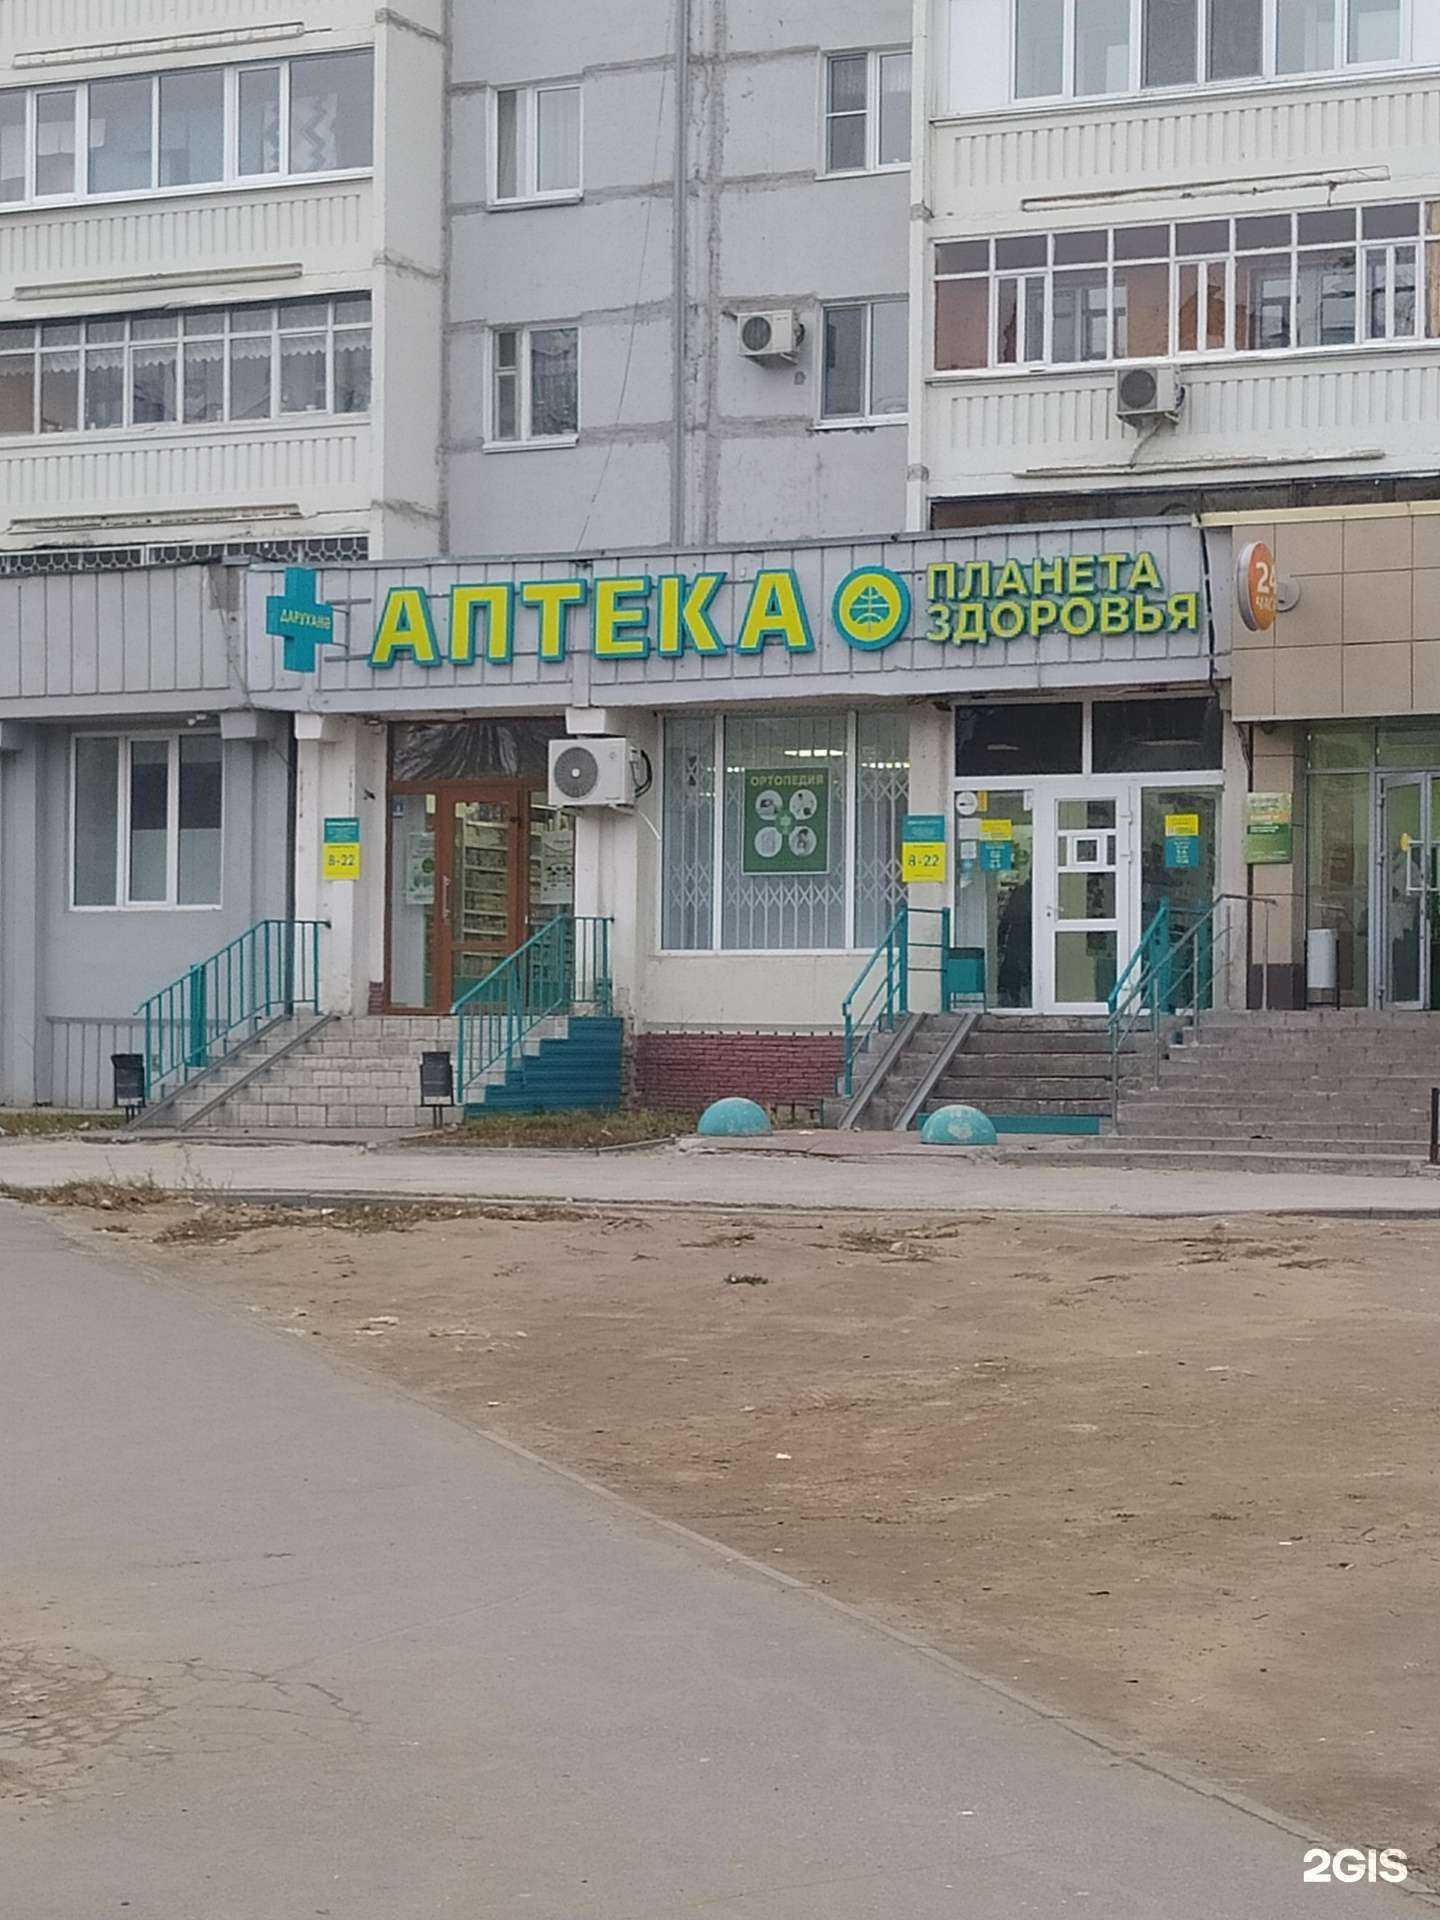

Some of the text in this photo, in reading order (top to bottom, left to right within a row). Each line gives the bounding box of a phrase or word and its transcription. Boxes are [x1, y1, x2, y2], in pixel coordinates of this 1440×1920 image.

[926, 551, 1165, 602] ПЛАНЕТА
[368, 568, 815, 668] АПТЕКА
[925, 592, 1200, 648] ЗДОРОВЬЯ
[750, 774, 824, 787] ОРТОПЕДИЯ
